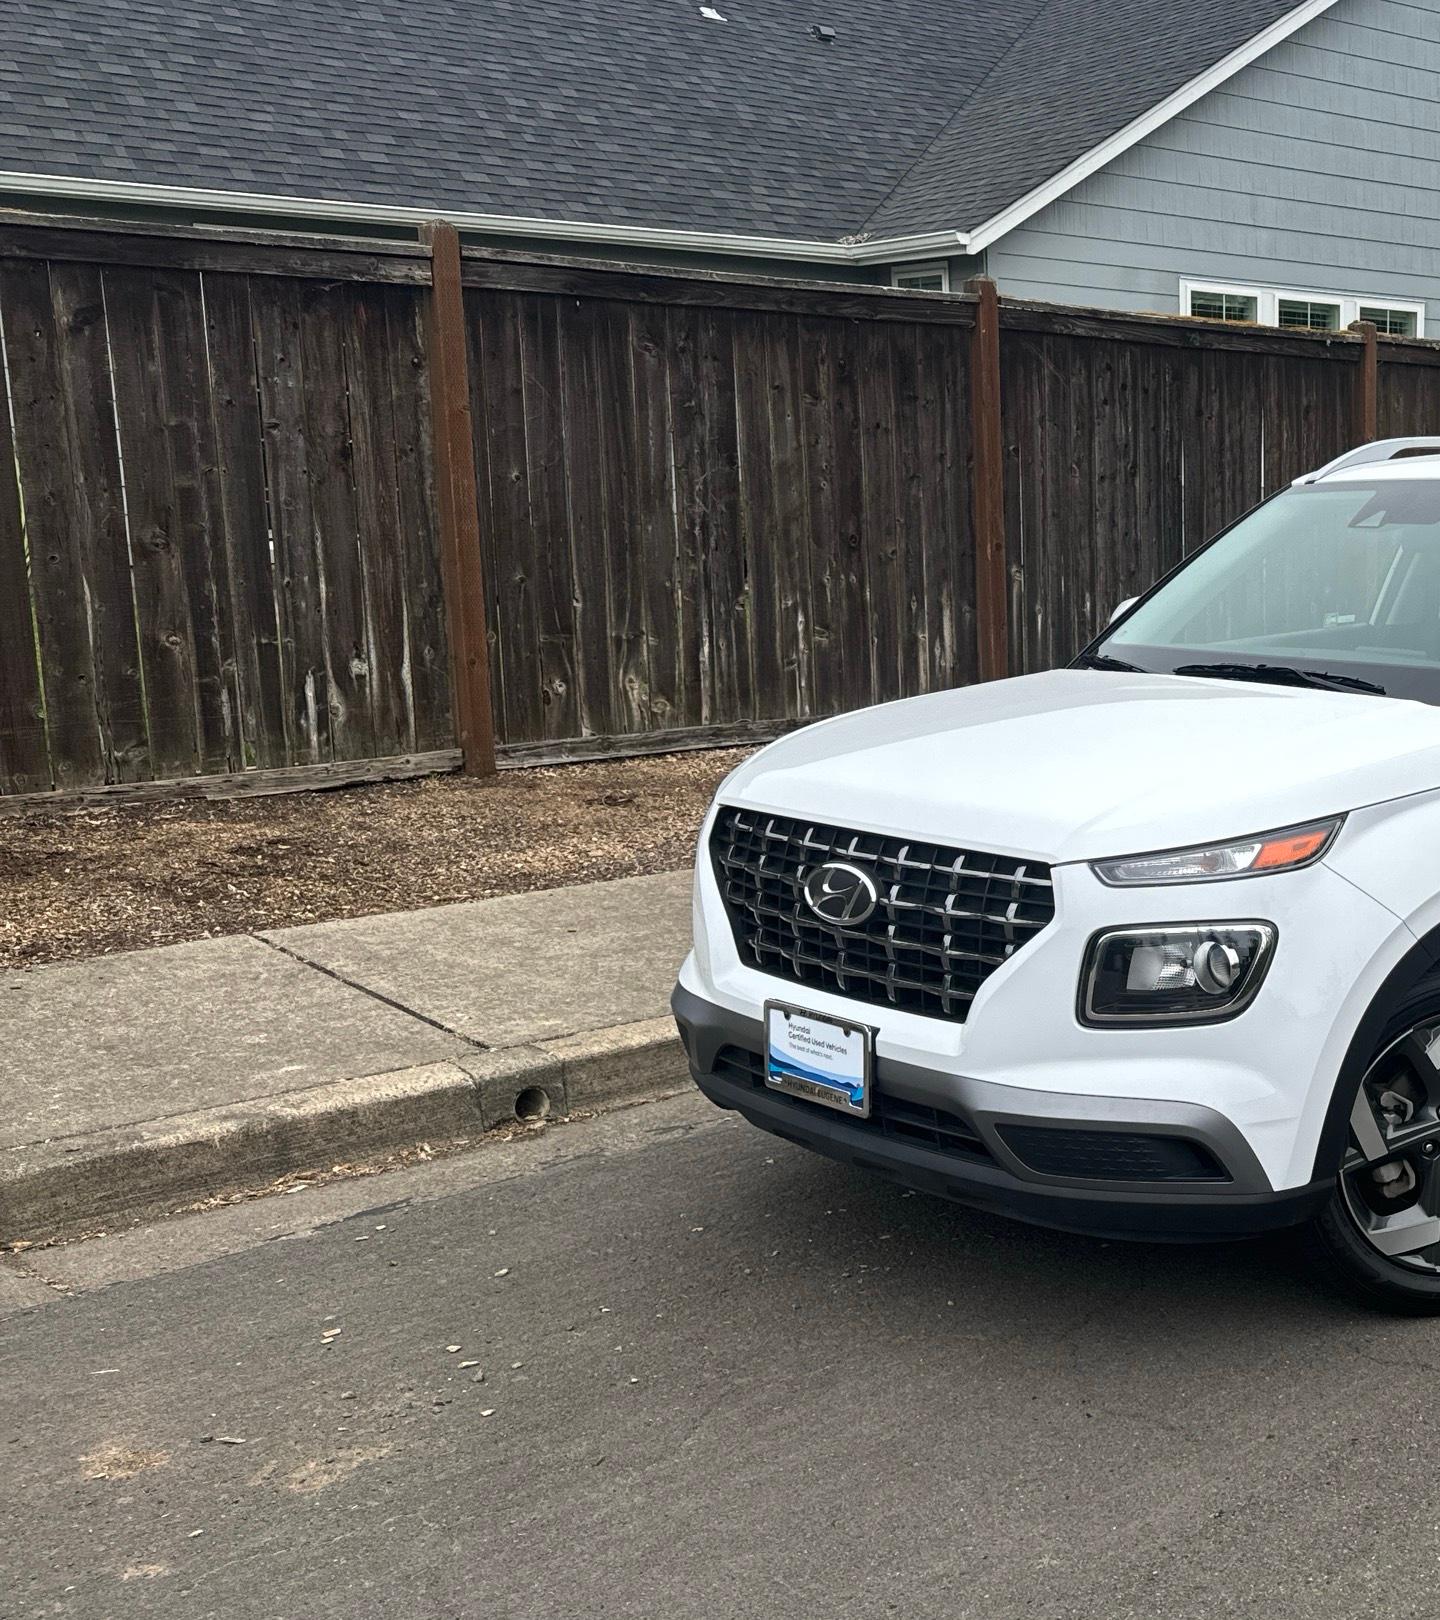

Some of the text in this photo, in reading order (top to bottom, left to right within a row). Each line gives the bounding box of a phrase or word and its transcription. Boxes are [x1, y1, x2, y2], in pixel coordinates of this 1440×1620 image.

[788, 1022, 811, 1035] Hyundai
[788, 1031, 847, 1055] Certified Used Vehicles
[787, 1081, 842, 1104] HYUNDAI EUGENE
